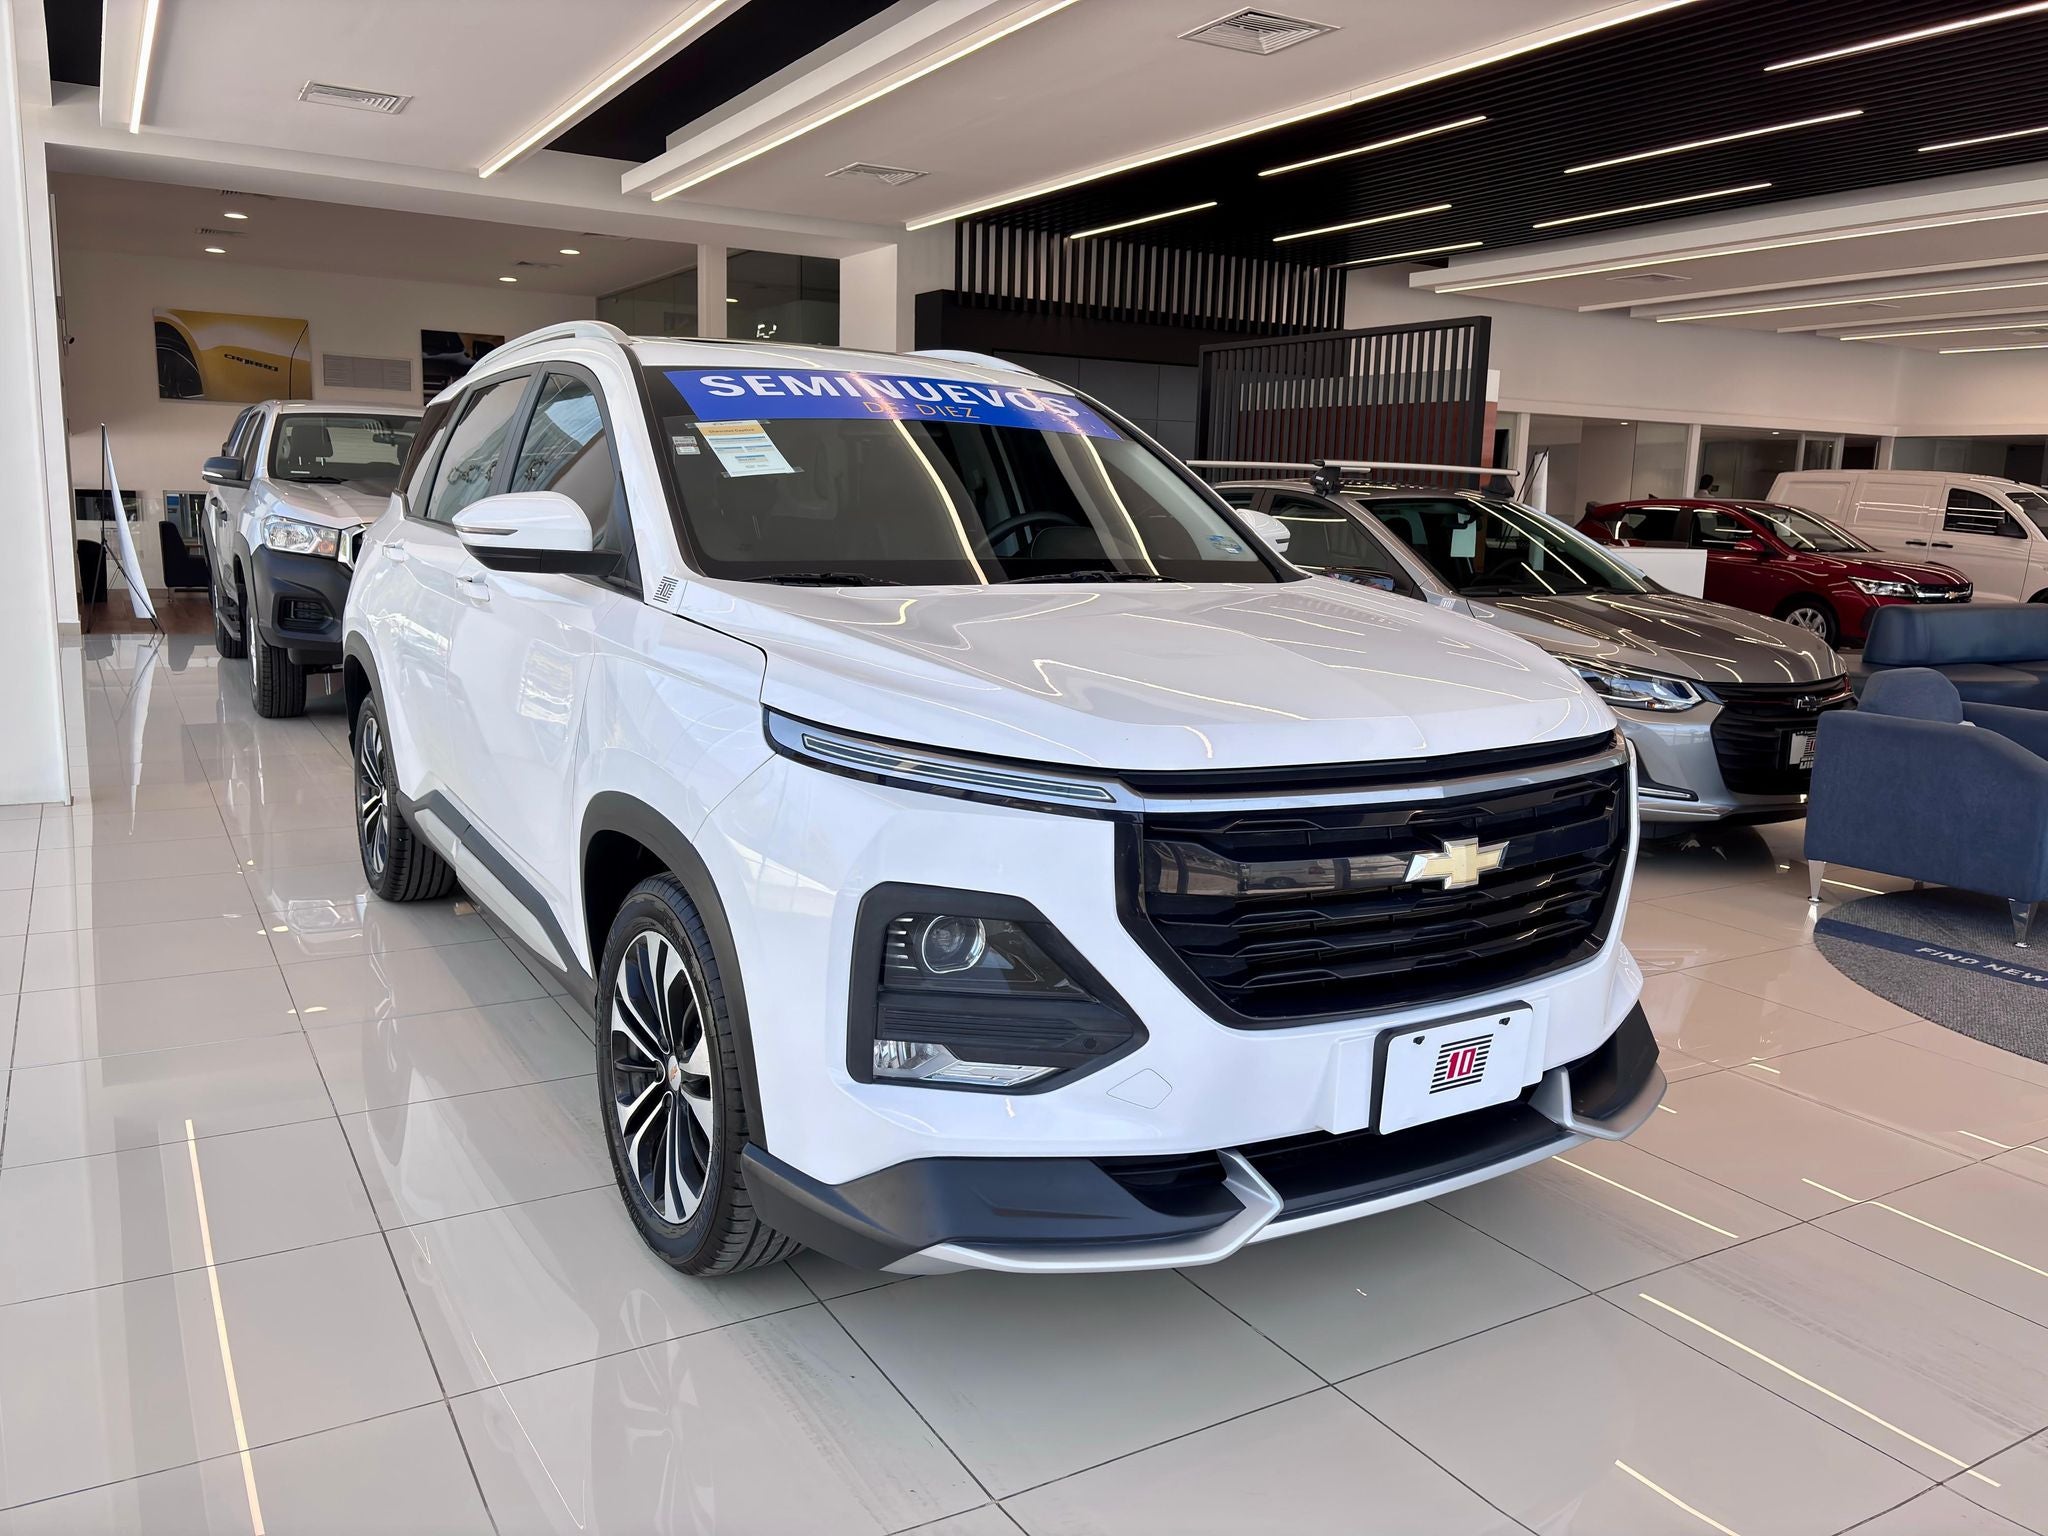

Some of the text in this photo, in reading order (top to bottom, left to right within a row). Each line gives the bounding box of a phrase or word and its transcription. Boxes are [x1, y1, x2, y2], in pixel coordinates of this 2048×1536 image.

[700, 375, 1079, 417] SEMINUEVOS
[863, 402, 980, 418] DE DIEZ
[1915, 947, 2048, 982] FIND NEW
[1446, 1047, 1477, 1080] 10
